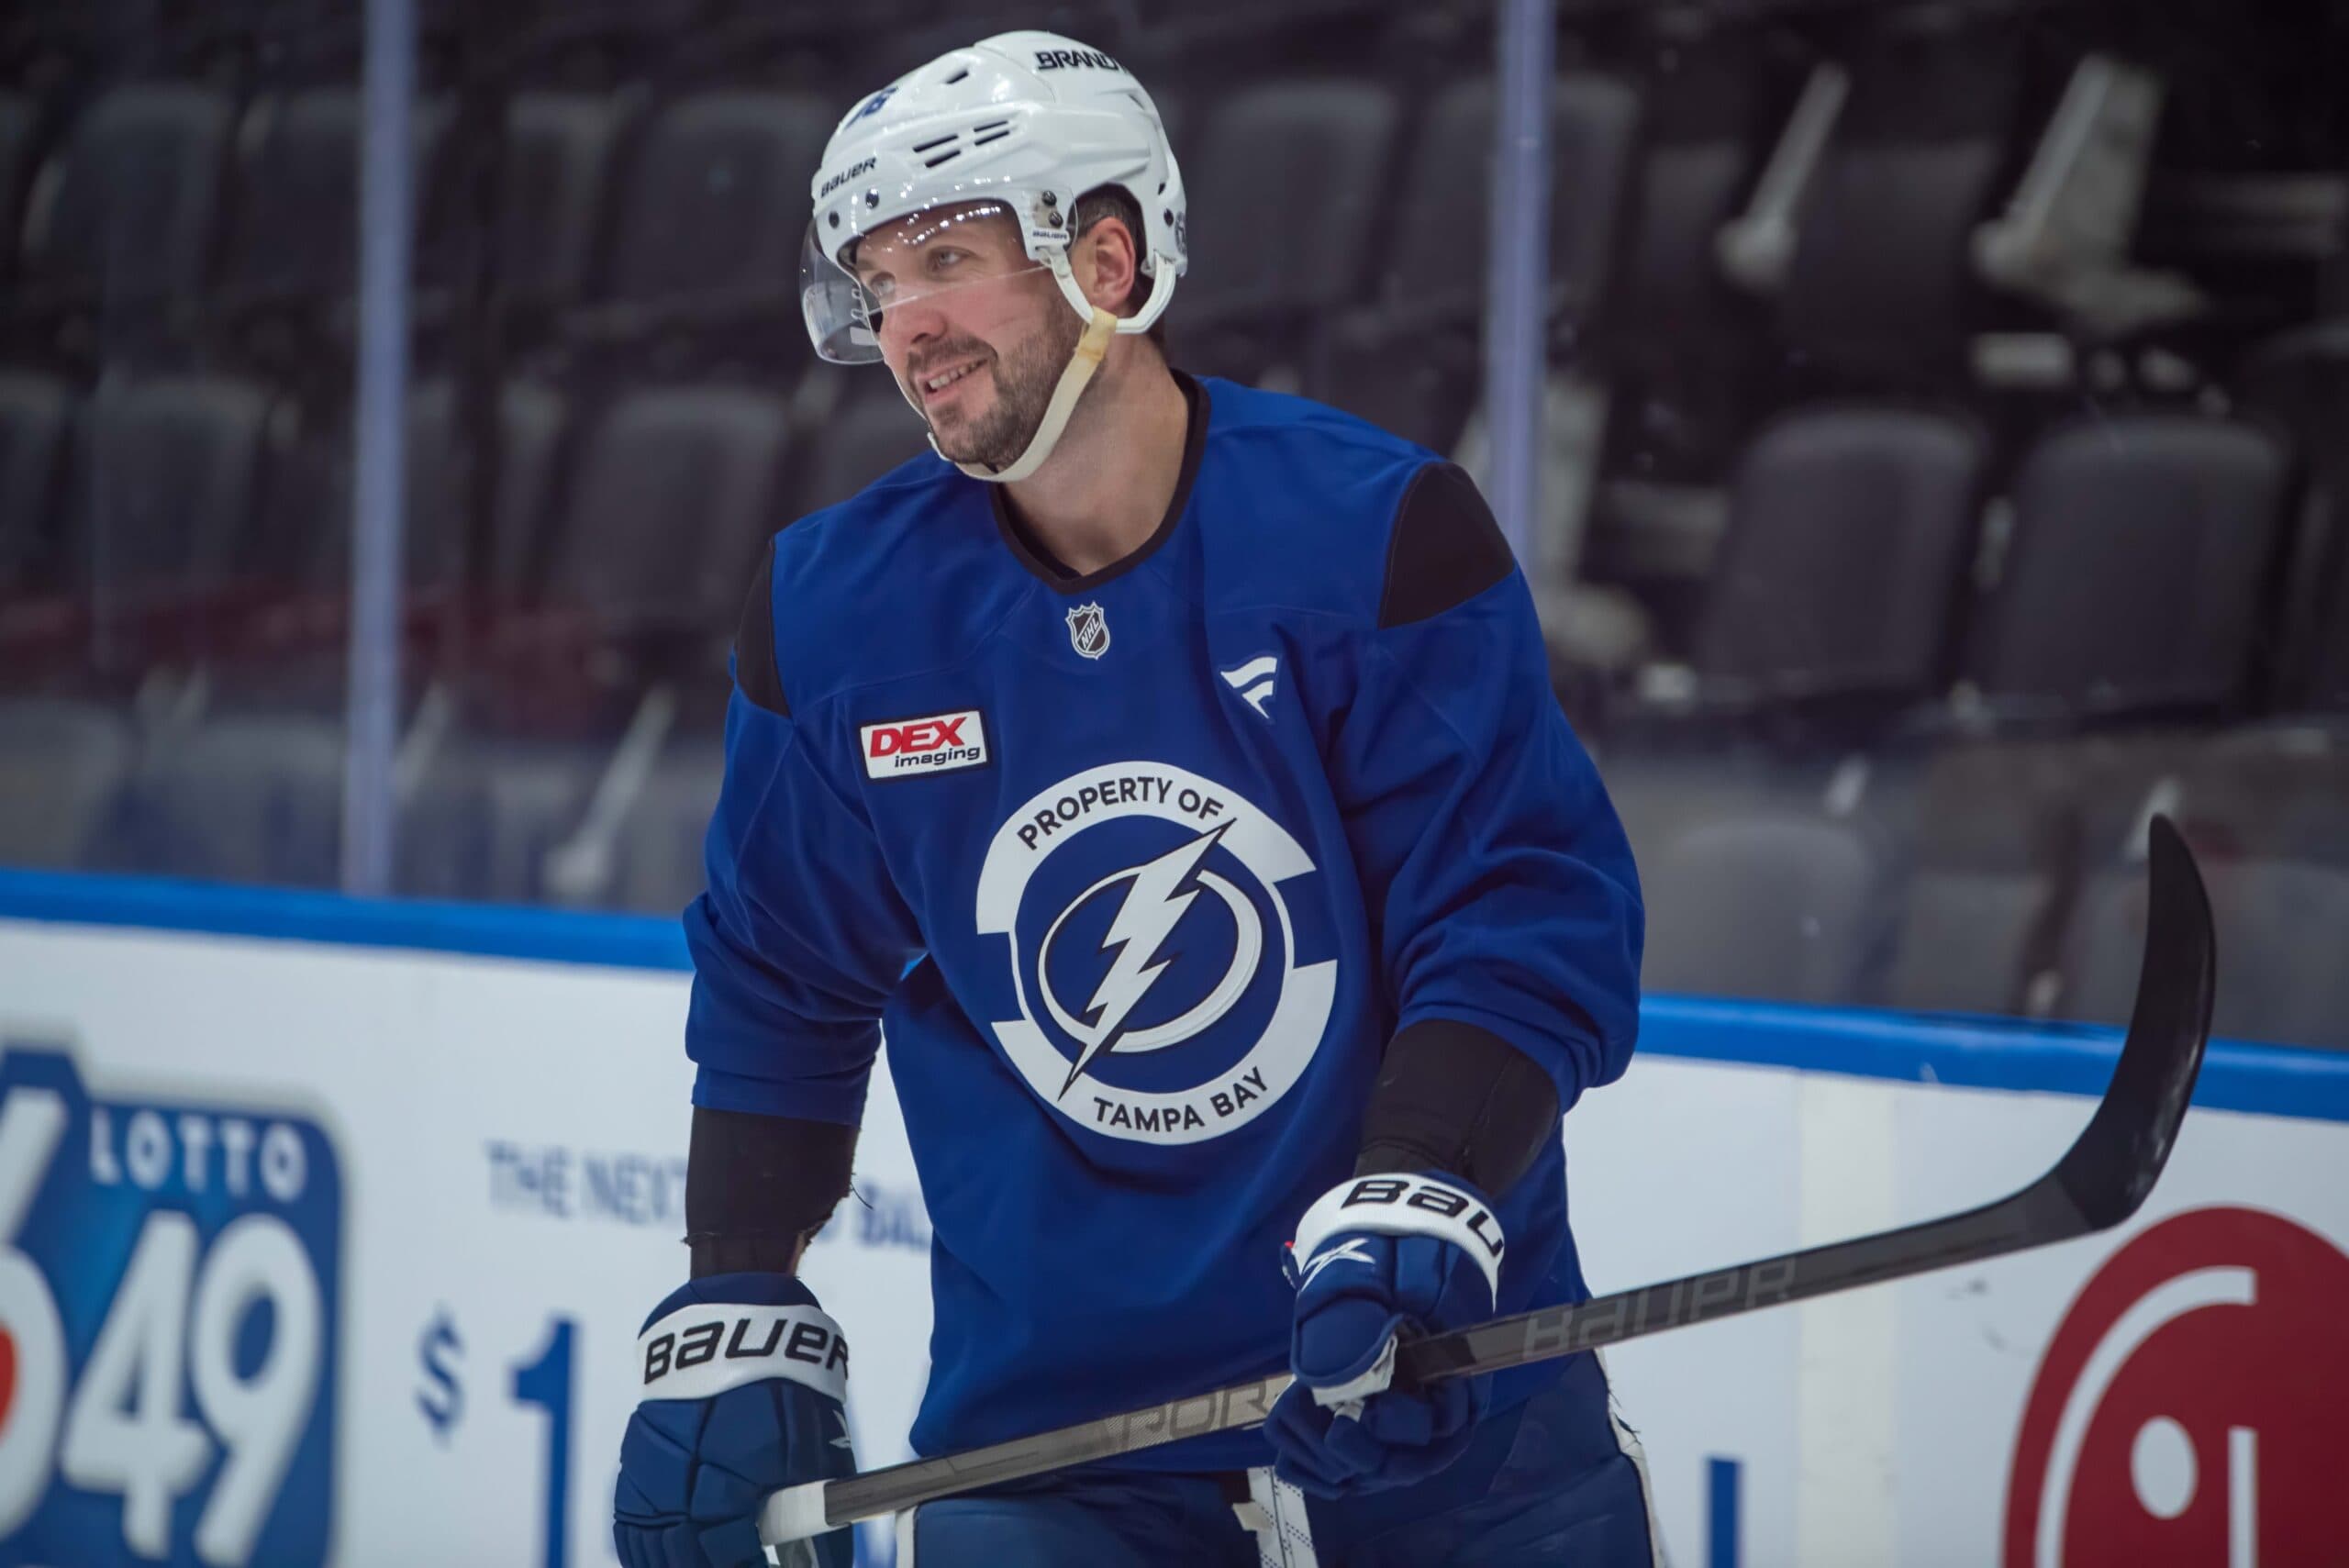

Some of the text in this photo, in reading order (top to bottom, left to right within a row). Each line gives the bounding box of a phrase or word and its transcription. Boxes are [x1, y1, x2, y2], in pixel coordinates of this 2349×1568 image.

[1034, 50, 1130, 74] BRAND
[1079, 610, 1100, 649] NHL
[869, 716, 968, 758] DEX
[894, 746, 981, 769] imaging
[1016, 776, 1224, 851] PROPERTY OF
[1093, 1065, 1268, 1133] TAMPA BAY
[90, 1106, 307, 1204] LOTTO
